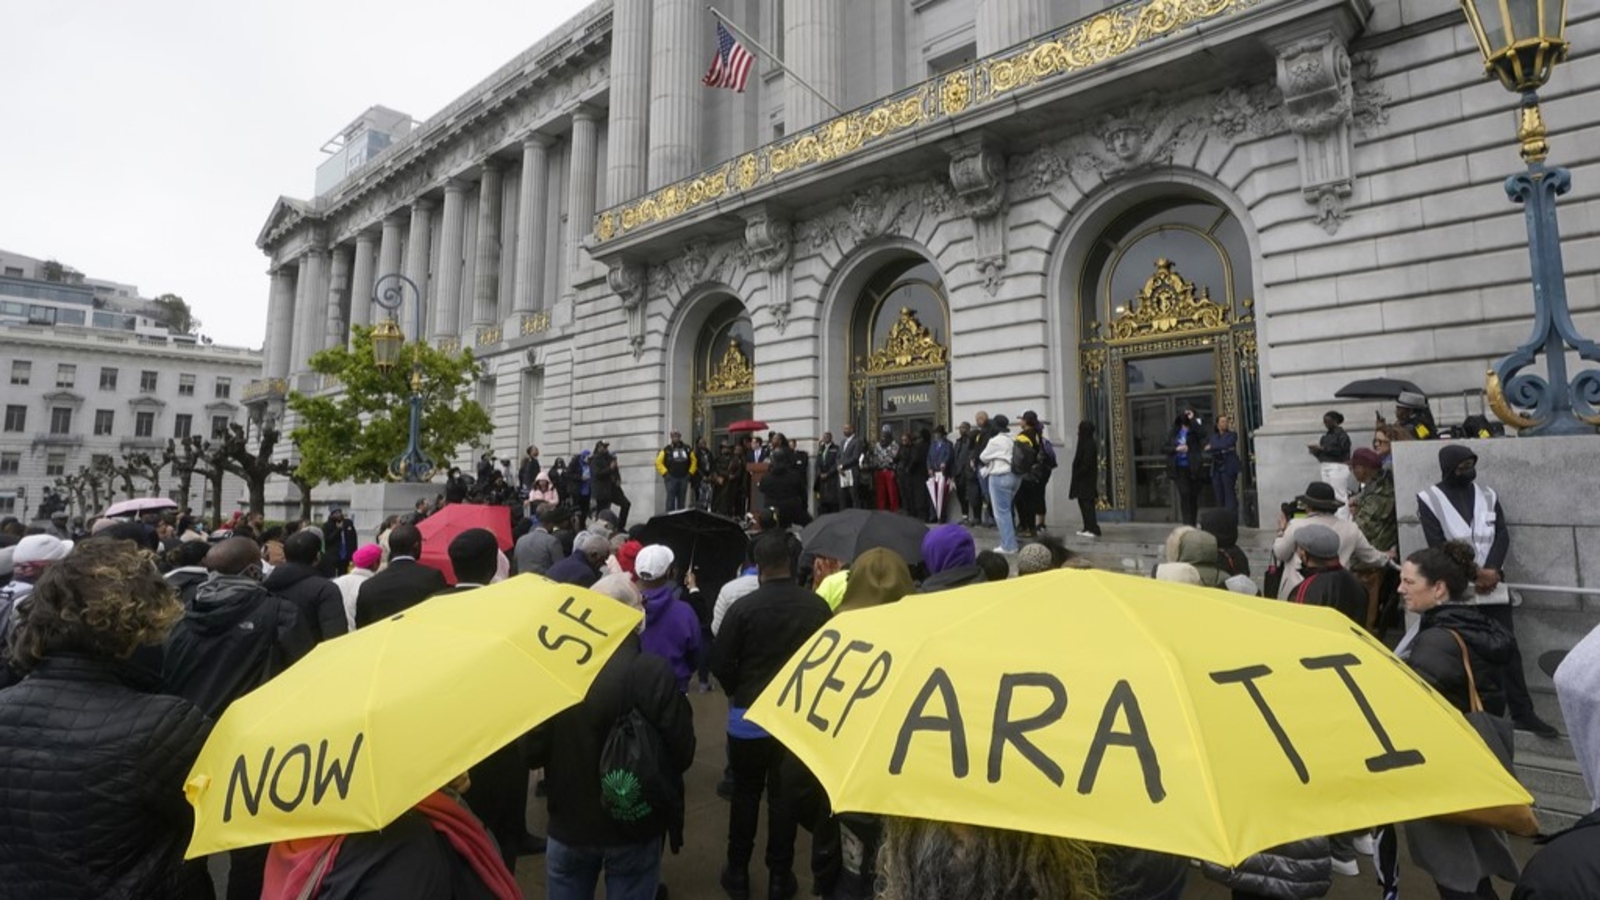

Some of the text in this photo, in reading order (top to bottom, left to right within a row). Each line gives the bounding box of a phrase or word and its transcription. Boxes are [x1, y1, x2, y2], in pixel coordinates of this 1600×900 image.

[908, 393, 930, 403] HALL
[537, 596, 609, 666] SF
[222, 732, 364, 824] NOW
